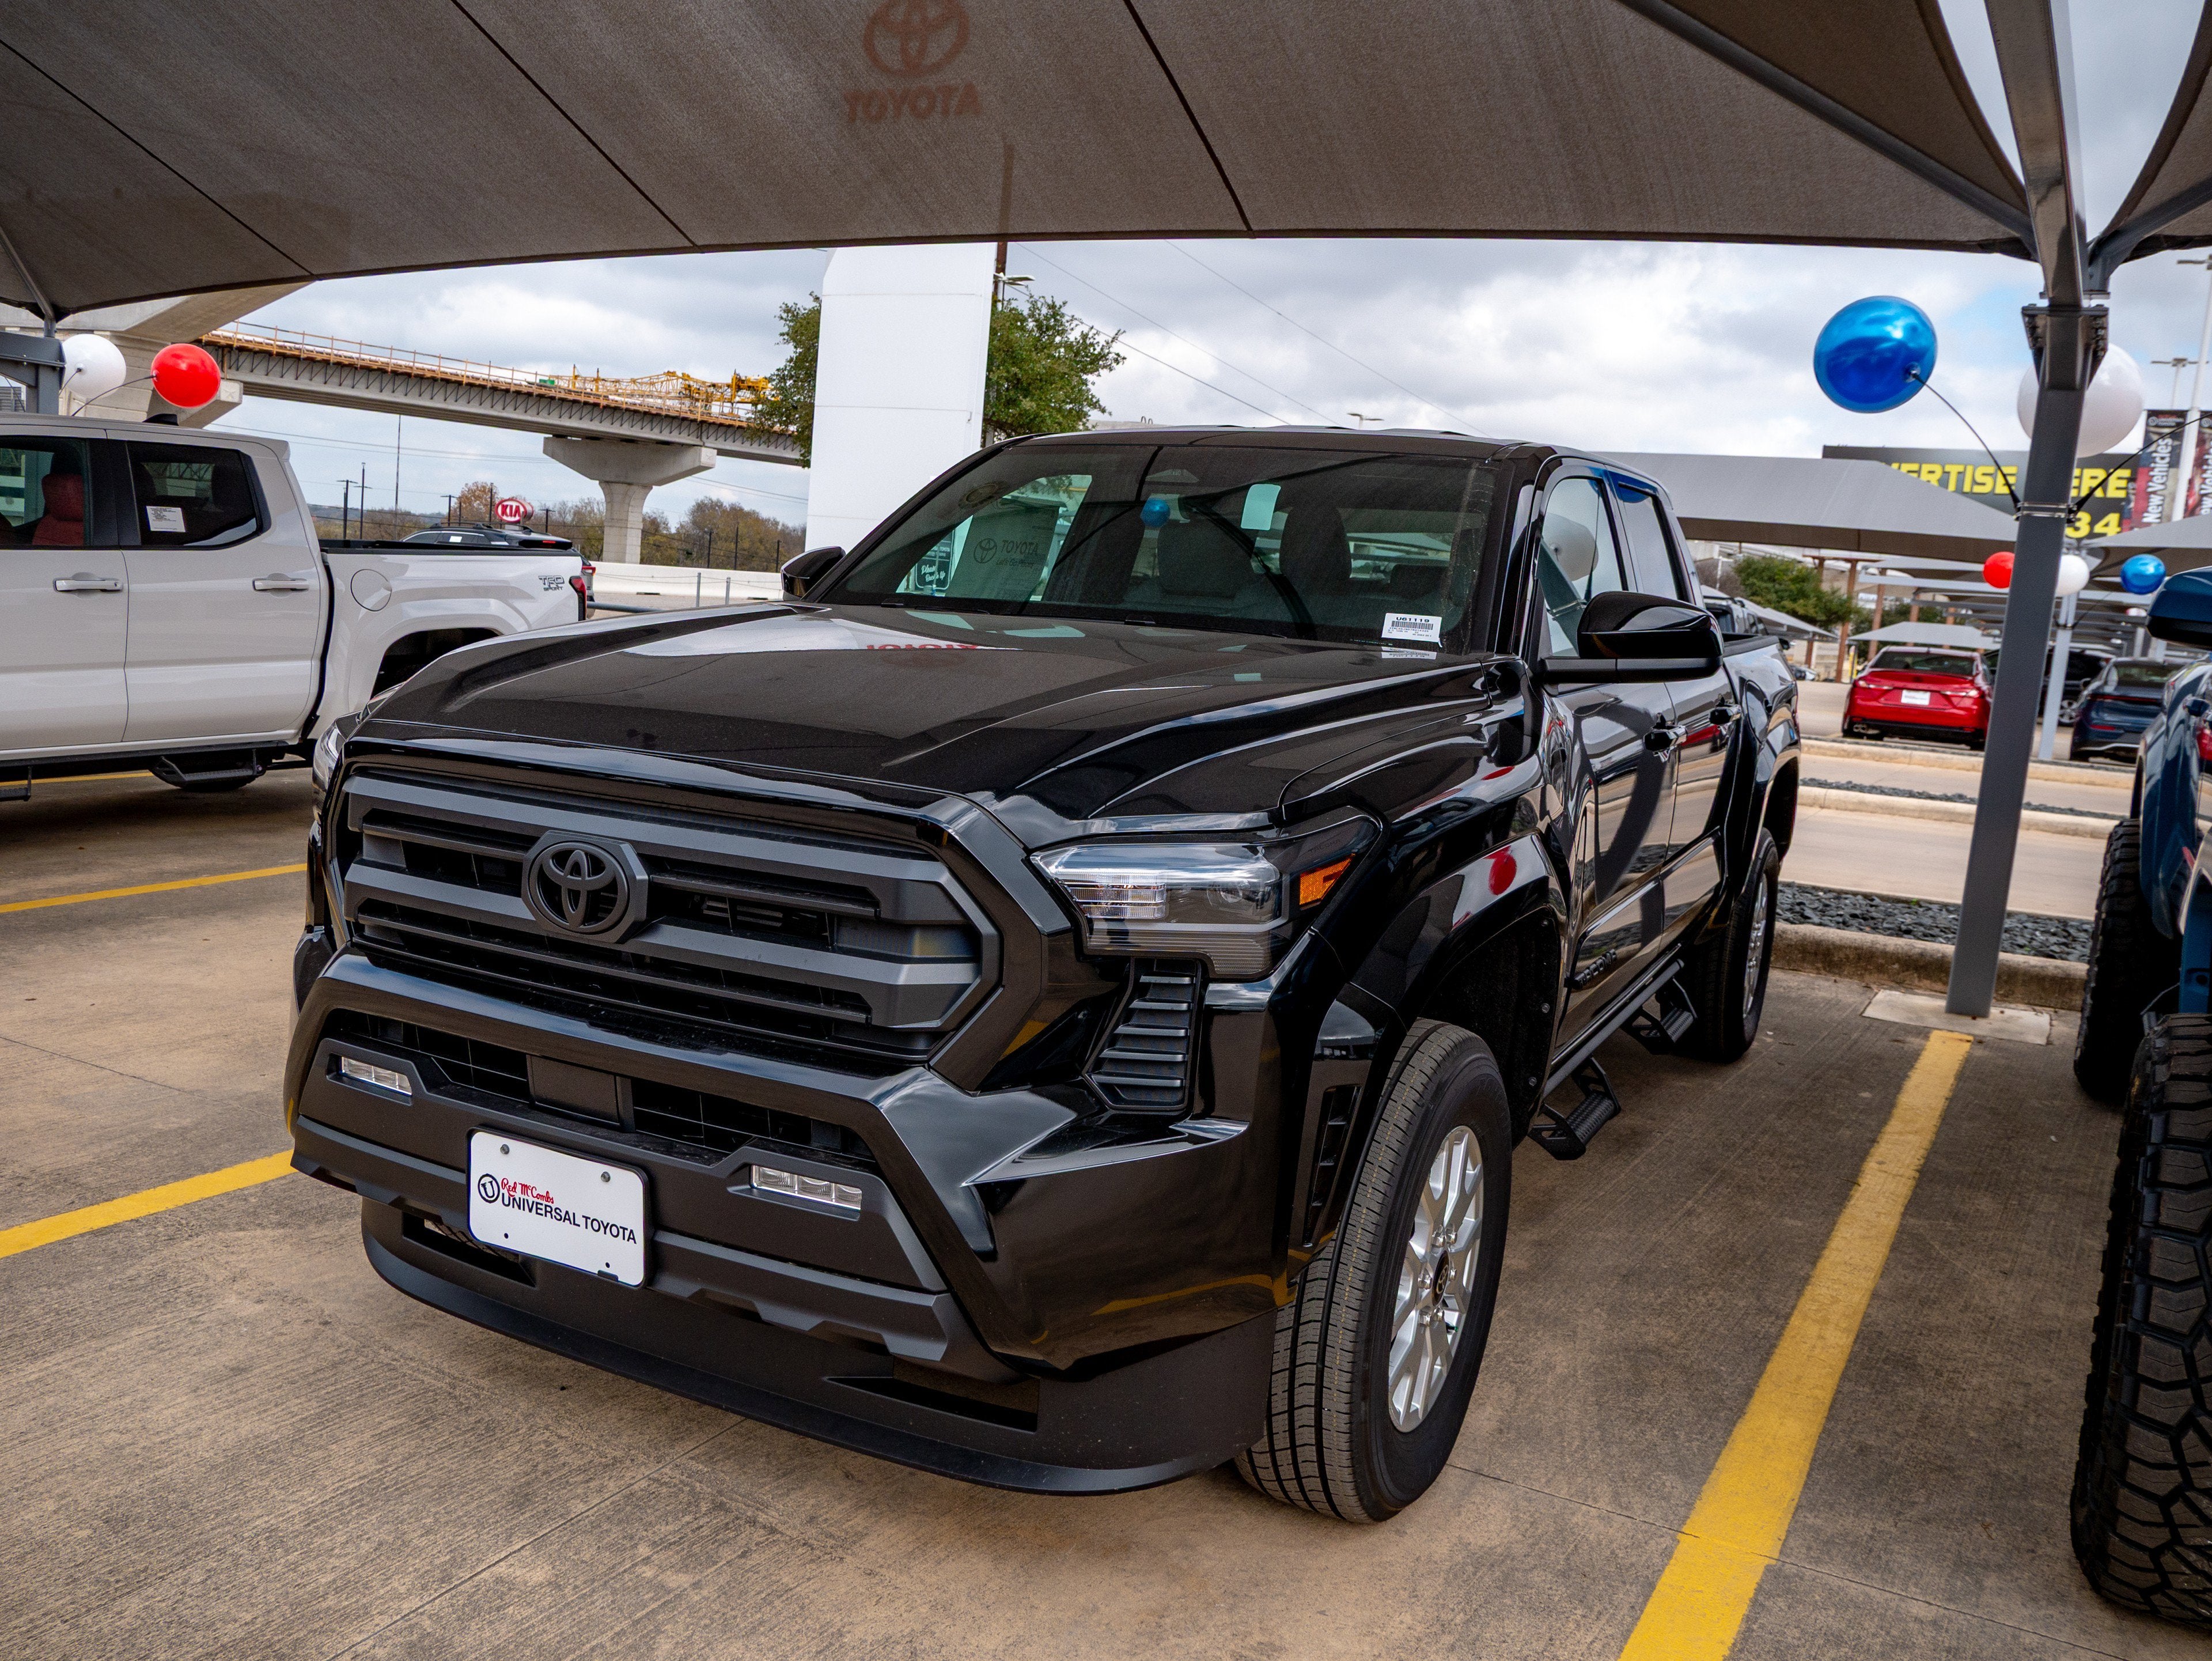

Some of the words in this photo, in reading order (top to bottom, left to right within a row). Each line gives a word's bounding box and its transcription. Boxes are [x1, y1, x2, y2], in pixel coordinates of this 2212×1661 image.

[842, 82, 980, 123] TOYOTA
[2146, 437, 2173, 493] Vehicles
[501, 504, 521, 517] KIA
[2141, 494, 2165, 524] New
[1001, 539, 1039, 556] TOYOTA
[537, 575, 565, 588] TRD
[921, 565, 937, 575] Pleas
[501, 1178, 517, 1197] Red
[518, 1182, 554, 1204] McCombs
[501, 1193, 581, 1228] UNIVERSAL
[582, 1214, 637, 1244] TOYOTA
